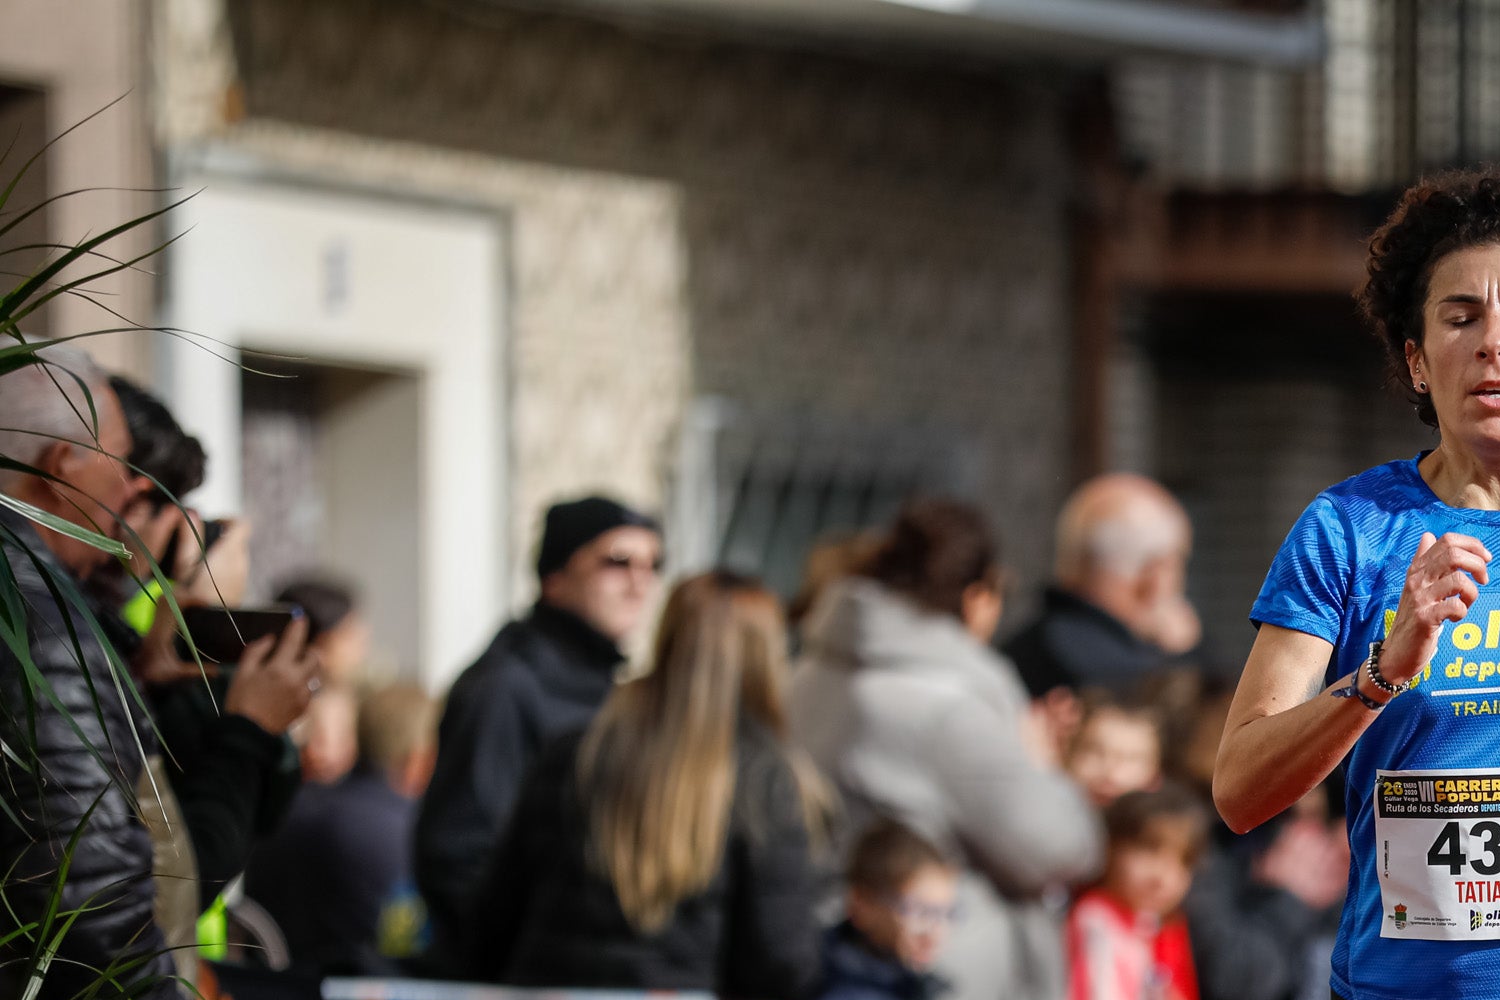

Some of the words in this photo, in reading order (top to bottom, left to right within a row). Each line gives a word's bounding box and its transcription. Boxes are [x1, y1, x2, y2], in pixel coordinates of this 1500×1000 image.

[1383, 782, 1404, 796] 26
[1386, 803, 1405, 813] Ruta
[1407, 804, 1417, 813] de
[1419, 804, 1432, 813] los
[1434, 804, 1479, 814] Secaderos
